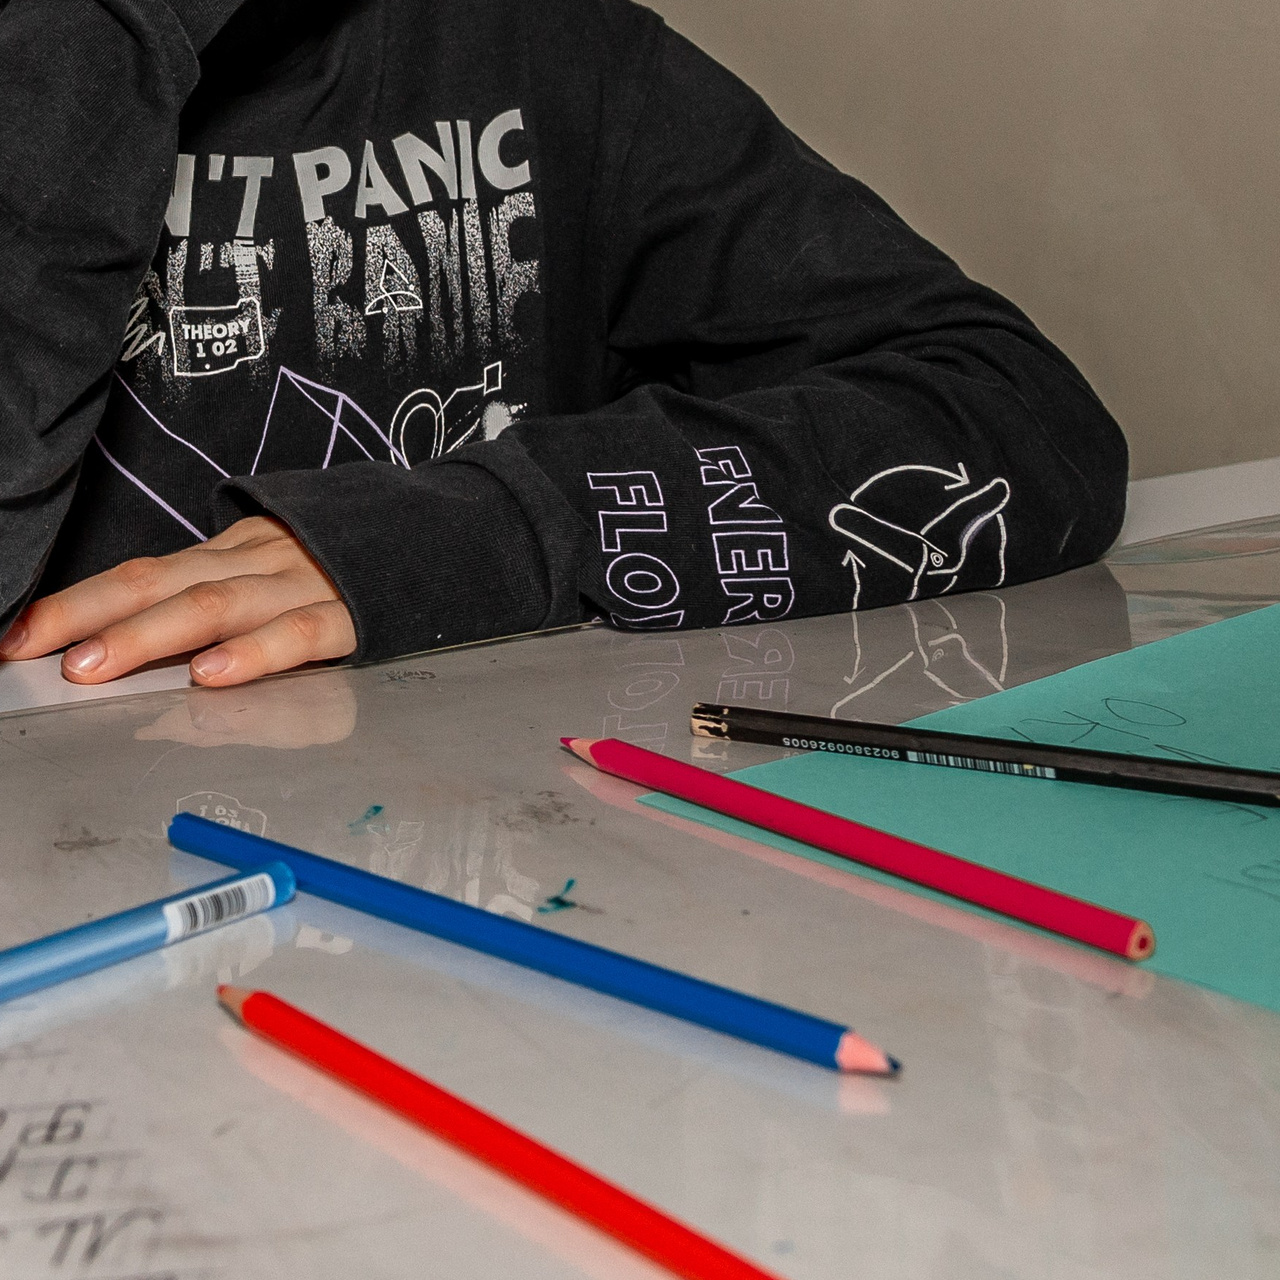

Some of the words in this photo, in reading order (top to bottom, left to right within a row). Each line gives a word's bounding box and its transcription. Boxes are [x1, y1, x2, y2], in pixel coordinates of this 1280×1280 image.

[164, 154, 274, 236] N'T
[293, 109, 531, 222] PANIC
[181, 318, 252, 341] THEORY
[782, 736, 900, 759] 9023800926005
